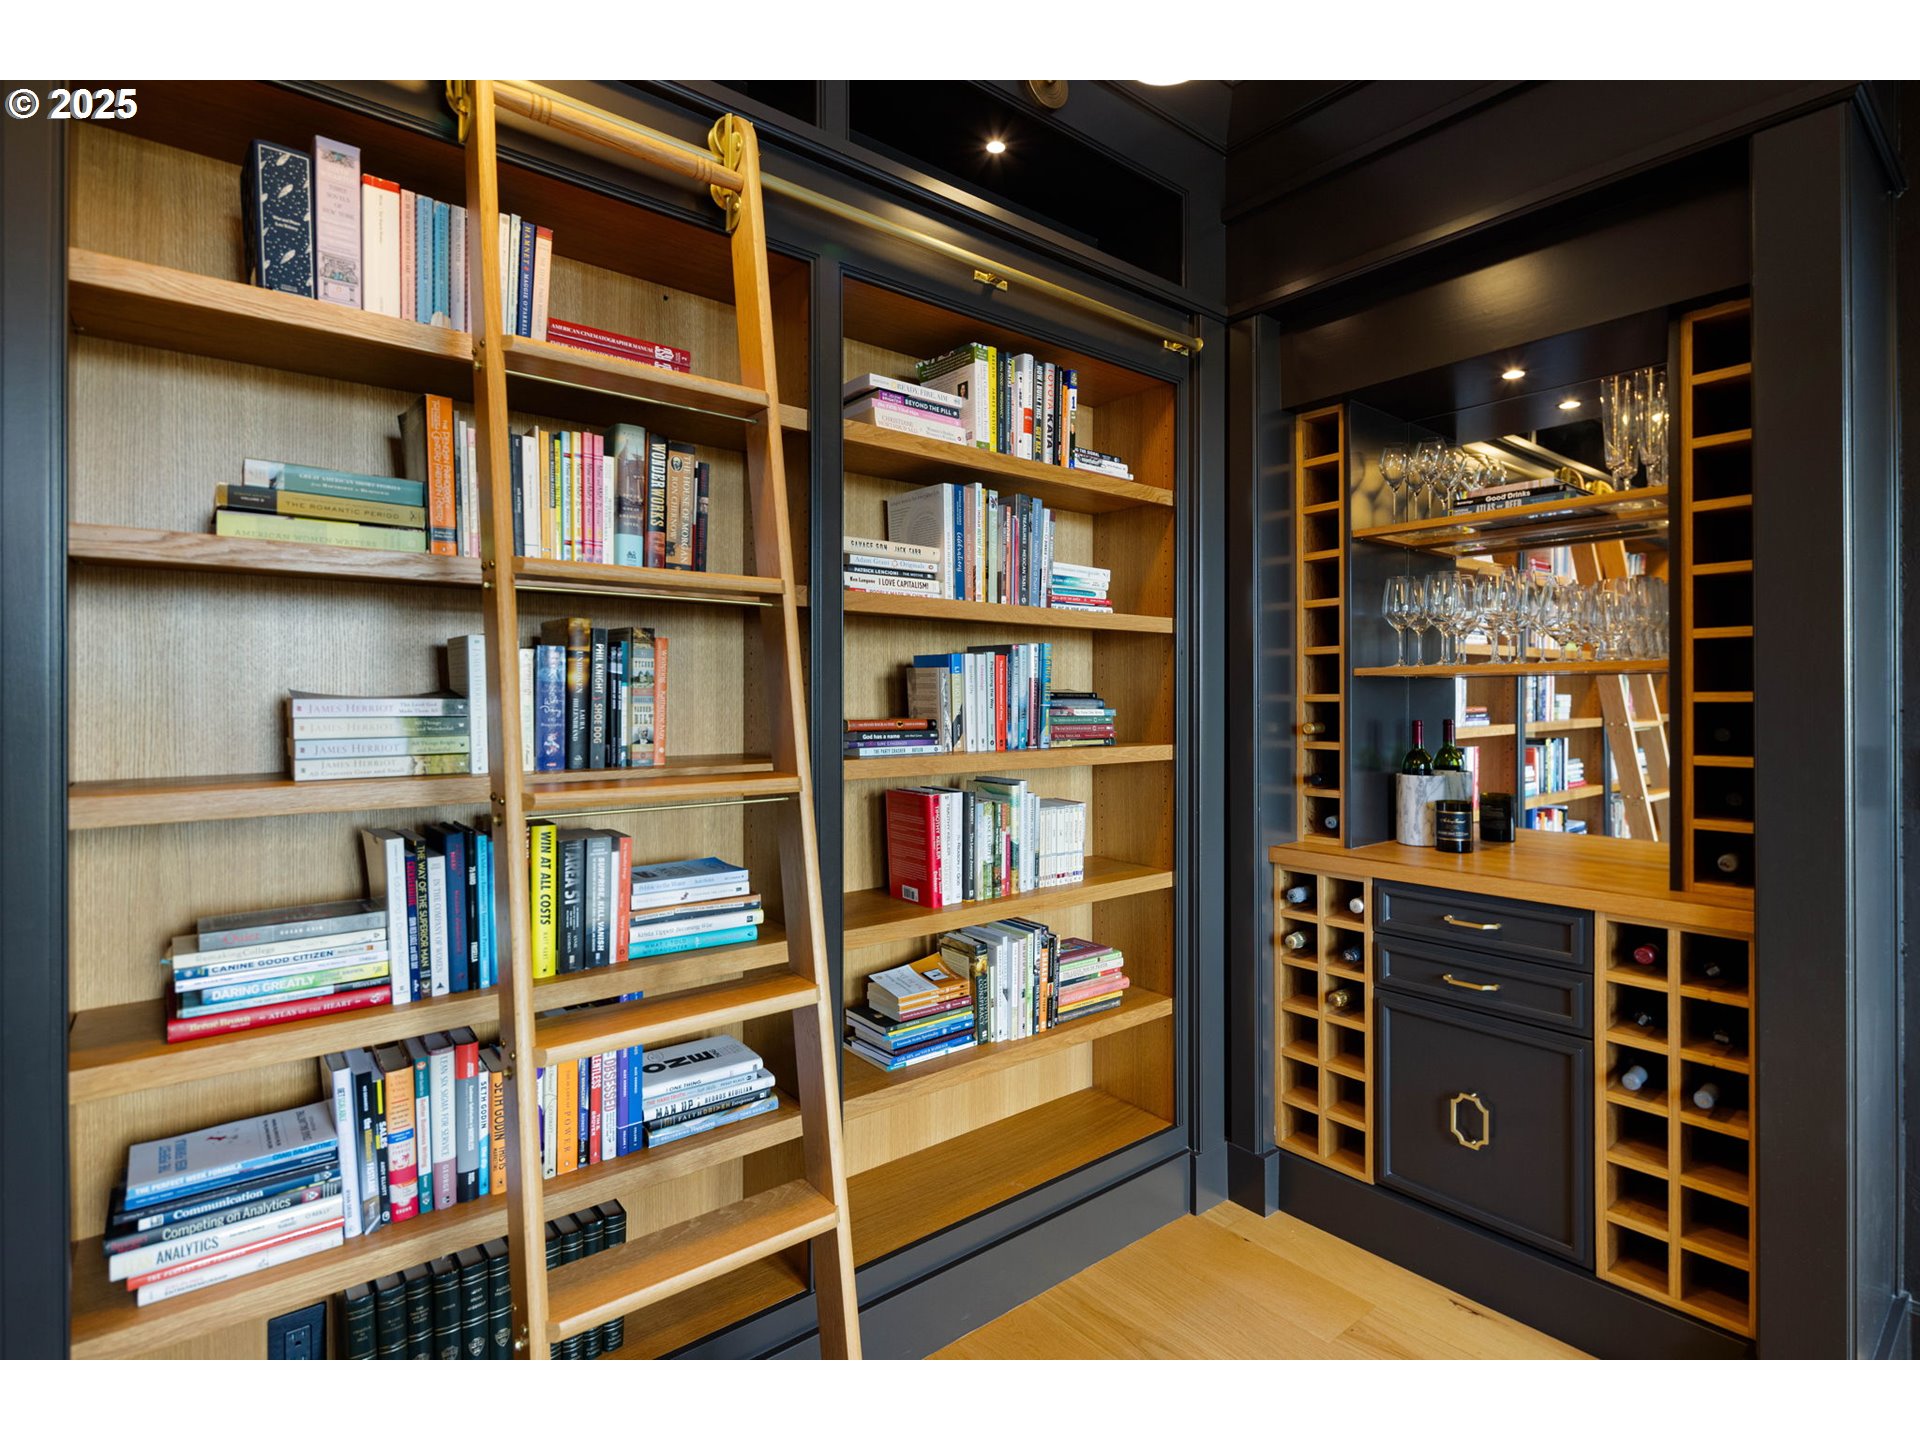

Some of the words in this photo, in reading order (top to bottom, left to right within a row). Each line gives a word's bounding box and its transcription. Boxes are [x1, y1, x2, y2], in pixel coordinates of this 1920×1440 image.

[523, 226, 532, 264] HAMNET
[552, 323, 581, 336] AMERICAN
[580, 330, 633, 348] CINEMATOGRAPHER
[633, 343, 653, 353] MANUAL
[905, 399, 928, 410] BEYOND
[650, 443, 666, 527] WONDERWORKS
[1476, 503, 1496, 512] ATLAS
[1505, 499, 1522, 508] BEER
[1485, 494, 1506, 502] Good
[1508, 491, 1530, 499] Drinks
[310, 503, 360, 515] ROMANTIC
[364, 508, 400, 519] PERIOD
[670, 496, 678, 539] CHERNOW
[682, 509, 689, 521] OF
[680, 523, 689, 563] MORGAN
[897, 580, 929, 589] CAPITALISM!
[595, 643, 604, 662] PHIL
[658, 650, 666, 684] Wintering
[594, 663, 604, 693] KNIGHT
[308, 704, 341, 714] JAMES
[346, 704, 394, 712] HERRIOT
[594, 703, 603, 724] SHOE
[309, 724, 344, 734] JAMES
[347, 723, 394, 732] HERRIOT
[593, 726, 603, 744] DOG
[314, 745, 348, 755] JAMES
[352, 744, 400, 753] HERRIOT
[321, 761, 350, 770] JAMES
[540, 832, 551, 853] WIN
[417, 846, 425, 860] THE
[541, 857, 551, 869] AT
[418, 861, 426, 880] WAY
[564, 852, 577, 888] AREA
[418, 881, 426, 892] OF
[433, 878, 439, 887] IN
[541, 873, 551, 890] ALL
[565, 891, 580, 905] 51
[541, 894, 551, 925] COSTS
[419, 910, 427, 946] SUPERIOR
[435, 936, 442, 946] OF
[211, 962, 254, 974] CANINE
[258, 956, 290, 967] GOOD
[293, 950, 334, 962] CITIZEN
[420, 948, 428, 967] MAN
[211, 985, 260, 1001] DARING
[262, 976, 317, 993] GREATLY
[220, 1016, 252, 1028] Brown
[268, 1010, 297, 1020] ATLAS
[323, 999, 352, 1011] HEART
[440, 1056, 449, 1075] LEAN
[604, 1059, 615, 1112] OBSESSED
[684, 1080, 702, 1088] THING
[494, 1082, 503, 1107] SETH
[655, 1106, 677, 1118] MAN
[682, 1100, 694, 1111] UP
[705, 1094, 726, 1104] BEDROS
[494, 1109, 504, 1141] GODIN
[442, 1129, 450, 1157] SERVICE
[173, 1189, 264, 1220] Communication
[162, 1216, 225, 1241] Competing
[227, 1210, 241, 1222] on
[243, 1197, 291, 1218] Analytics
[156, 1236, 220, 1265] ANALYTICS
